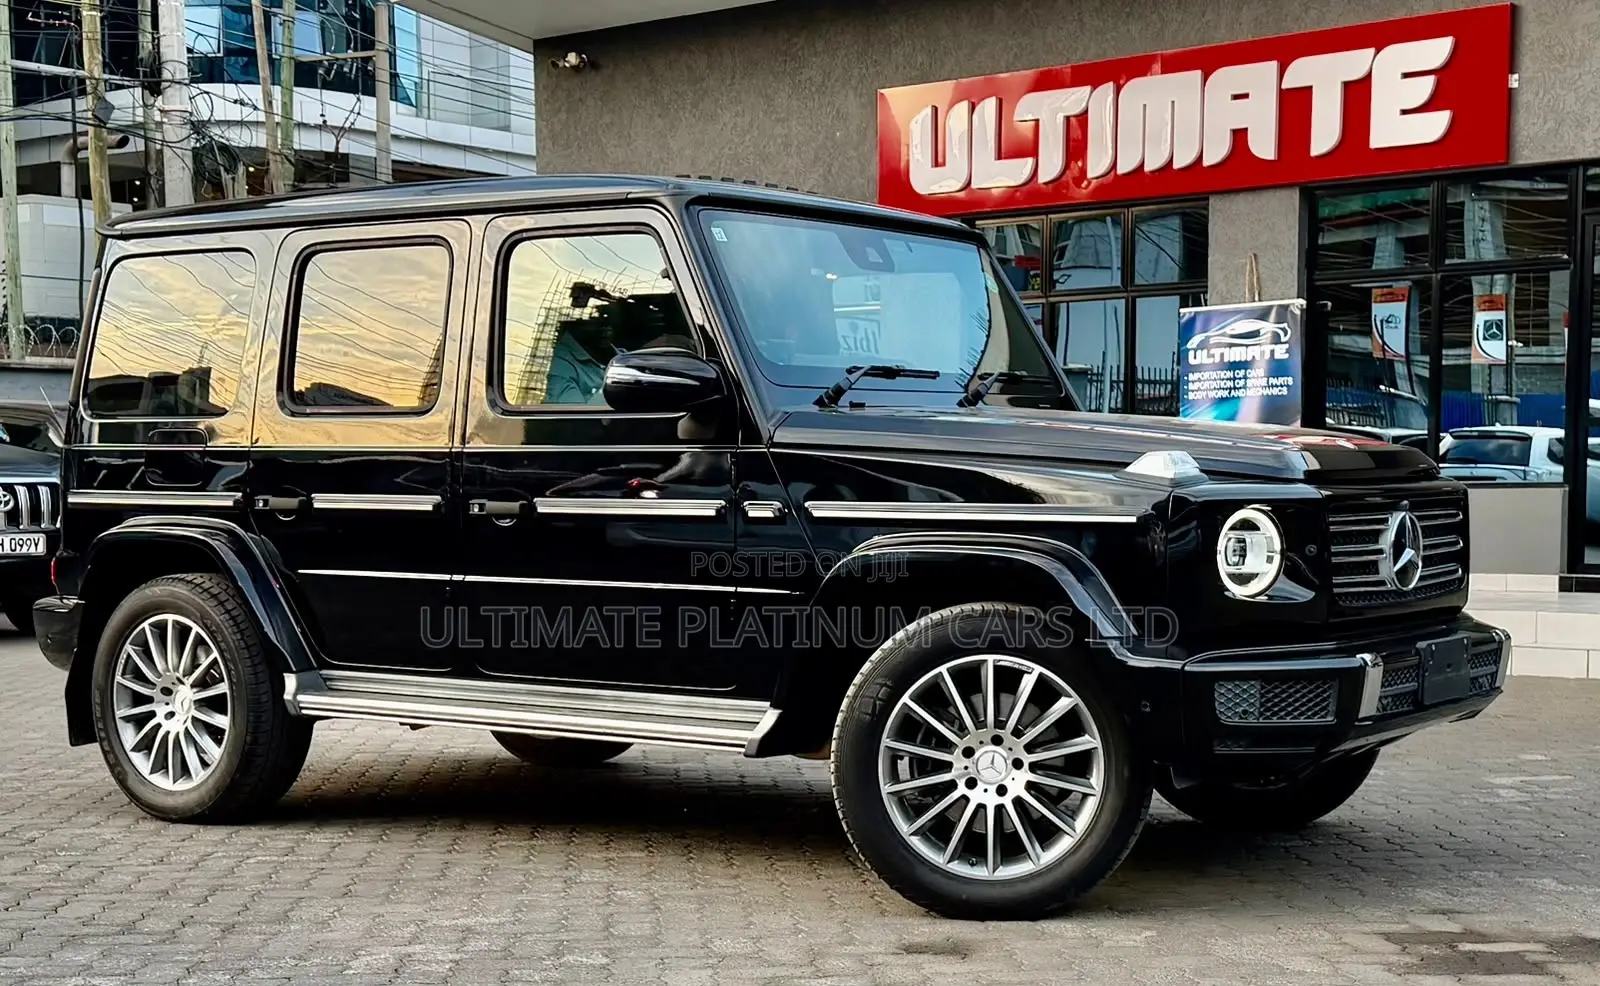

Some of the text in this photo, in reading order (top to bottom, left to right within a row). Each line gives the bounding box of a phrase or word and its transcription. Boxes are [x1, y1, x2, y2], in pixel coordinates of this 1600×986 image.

[908, 35, 1455, 196] ULTIMATE
[1188, 343, 1290, 365] ULTIMATE
[1188, 368, 1265, 381] IMPORTATION OF CARS
[1188, 376, 1293, 390] IMPORTATION OF SPARE PARTS
[1188, 386, 1288, 400] BODY WORK AND MECHANICS
[9, 537, 41, 552] 099Y
